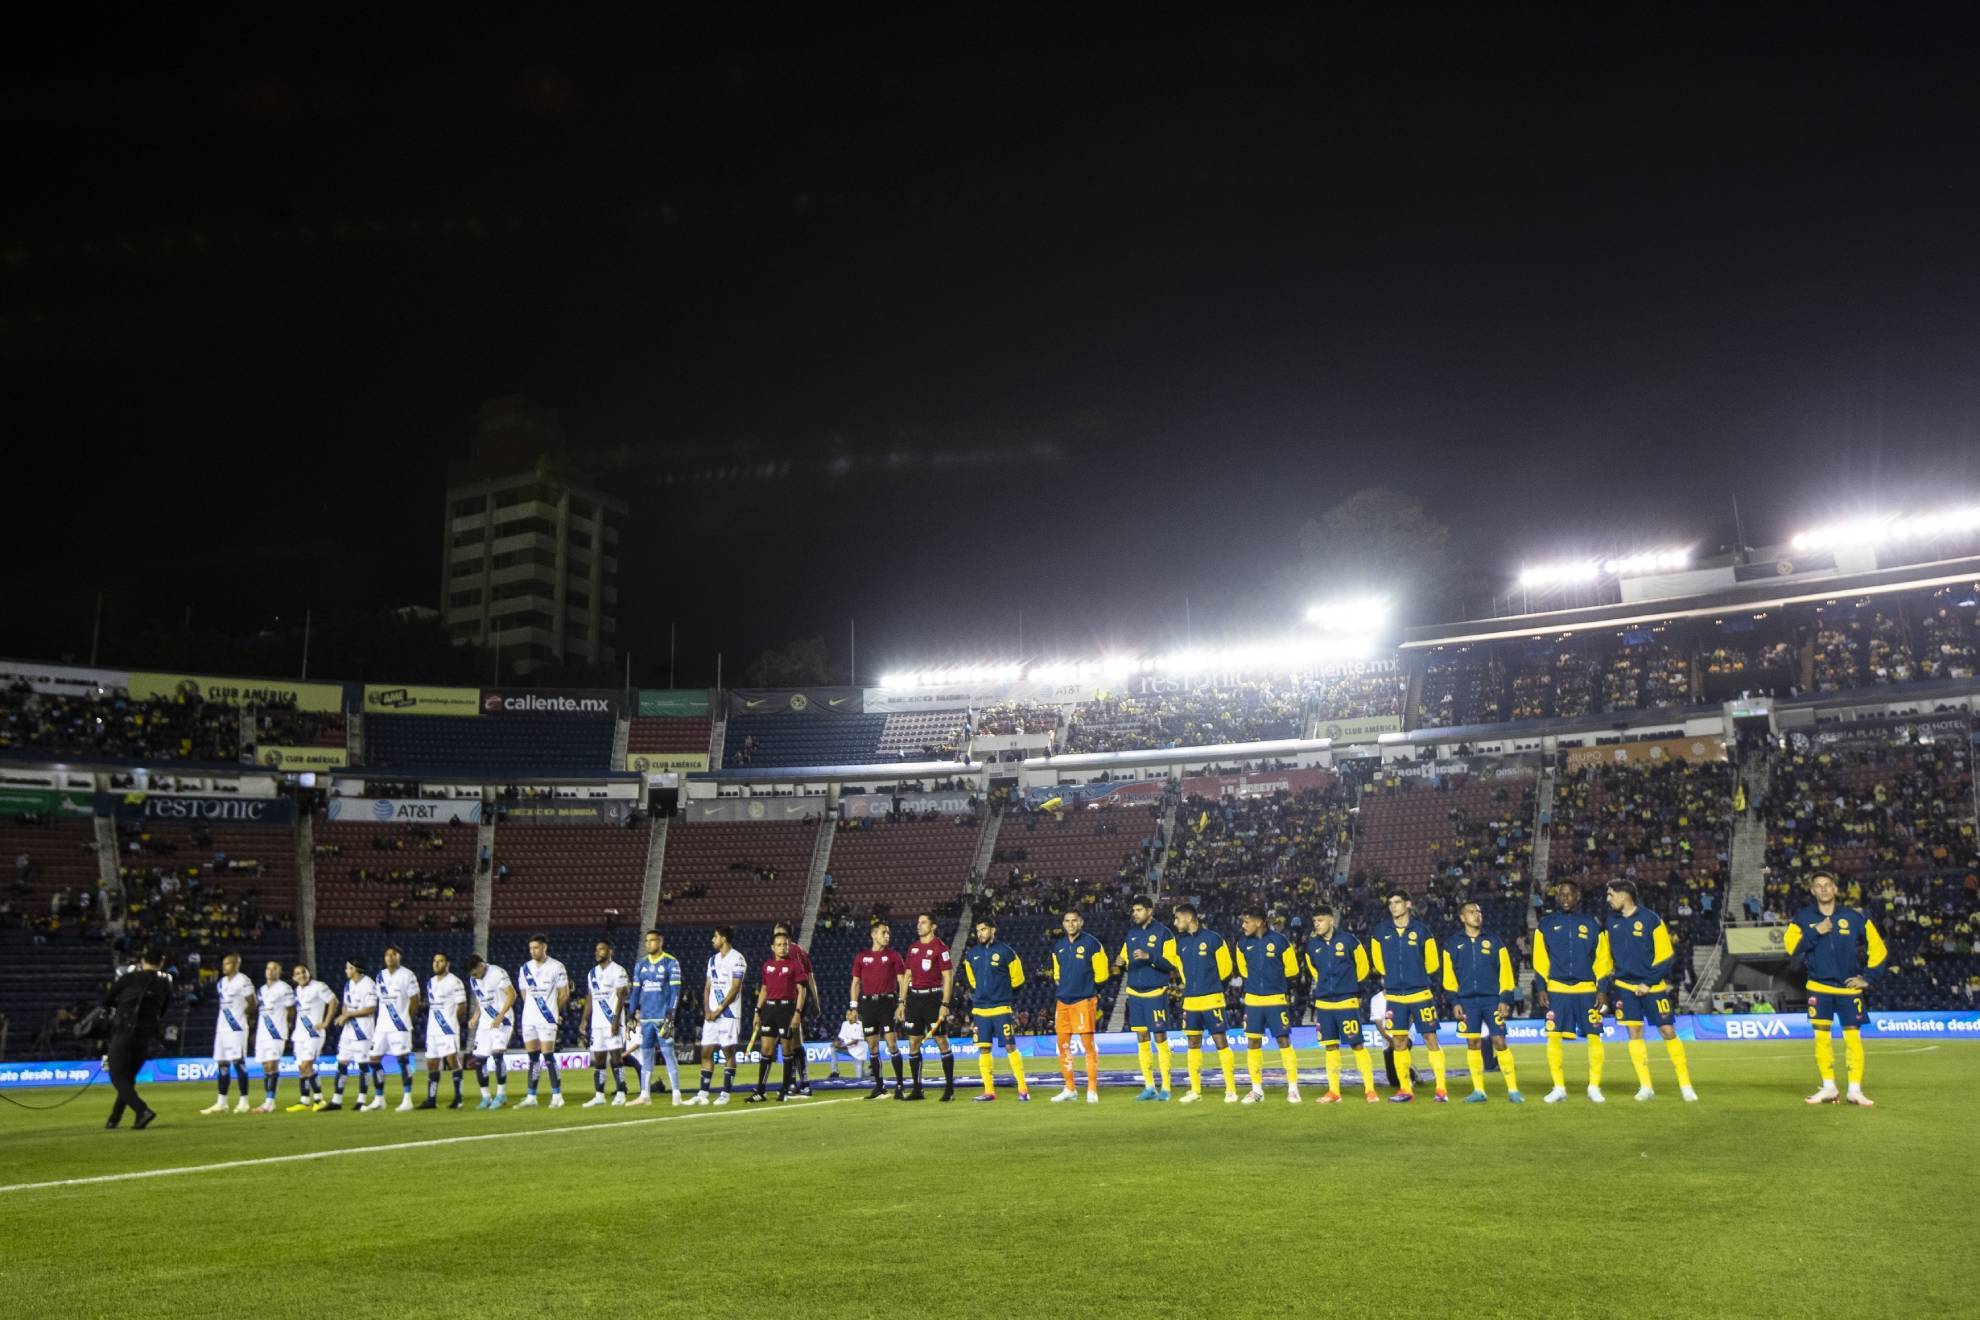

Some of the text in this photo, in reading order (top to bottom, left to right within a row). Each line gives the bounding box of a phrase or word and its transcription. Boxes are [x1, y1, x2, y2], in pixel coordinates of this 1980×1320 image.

[209, 685, 298, 703] CLUB AMÉRICA
[504, 694, 609, 712] caliente.mx
[1856, 728, 1888, 738] PLAZA
[1895, 723, 1930, 735] NUVO
[1932, 719, 1966, 731] HOTEL
[397, 805, 438, 818] AT&T
[870, 797, 970, 814] calente.mx
[1656, 998, 1670, 1013] 10
[1153, 1009, 1166, 1022] 14
[1213, 1008, 1223, 1021] 4
[1280, 1011, 1289, 1025] 6
[1343, 1020, 1359, 1035] 20
[1726, 1019, 1790, 1039] BBVA
[1877, 1018, 1945, 1032] Cámbiate
[20, 1068, 53, 1081] desde
